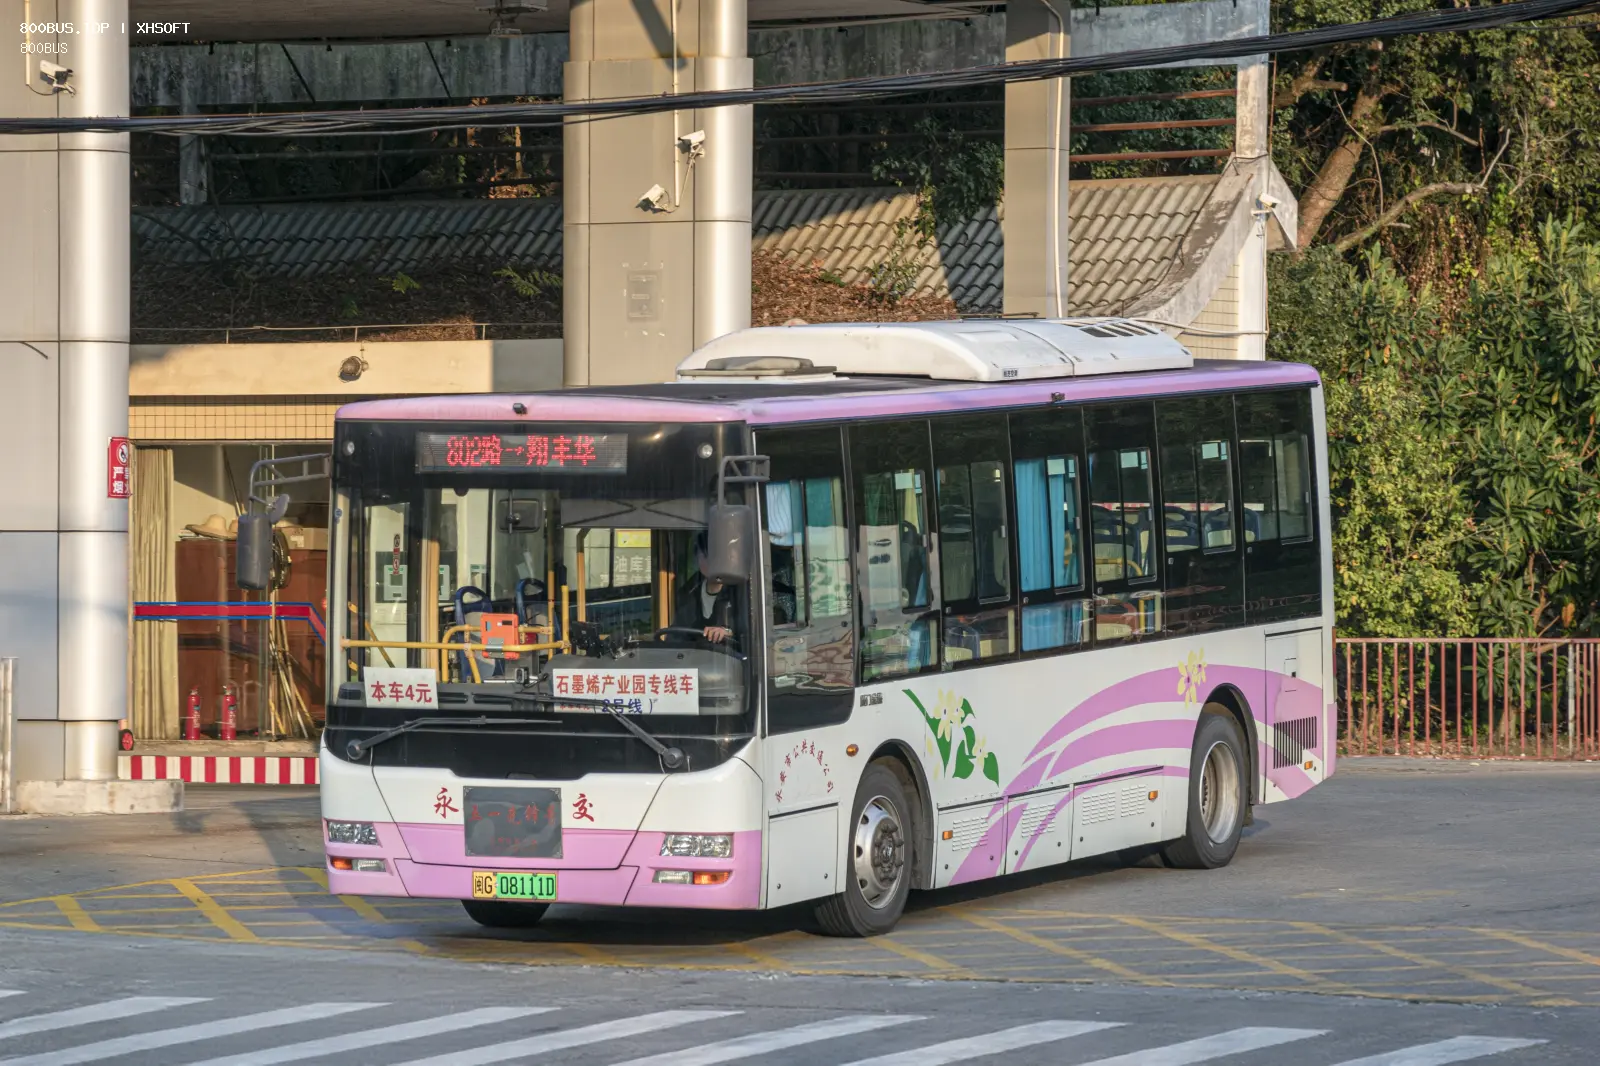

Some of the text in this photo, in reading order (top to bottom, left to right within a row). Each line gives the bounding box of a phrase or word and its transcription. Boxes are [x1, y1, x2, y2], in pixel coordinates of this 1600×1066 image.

[371, 680, 432, 703] 本车4元
[556, 674, 694, 695] 石墨烯产业园专线车
